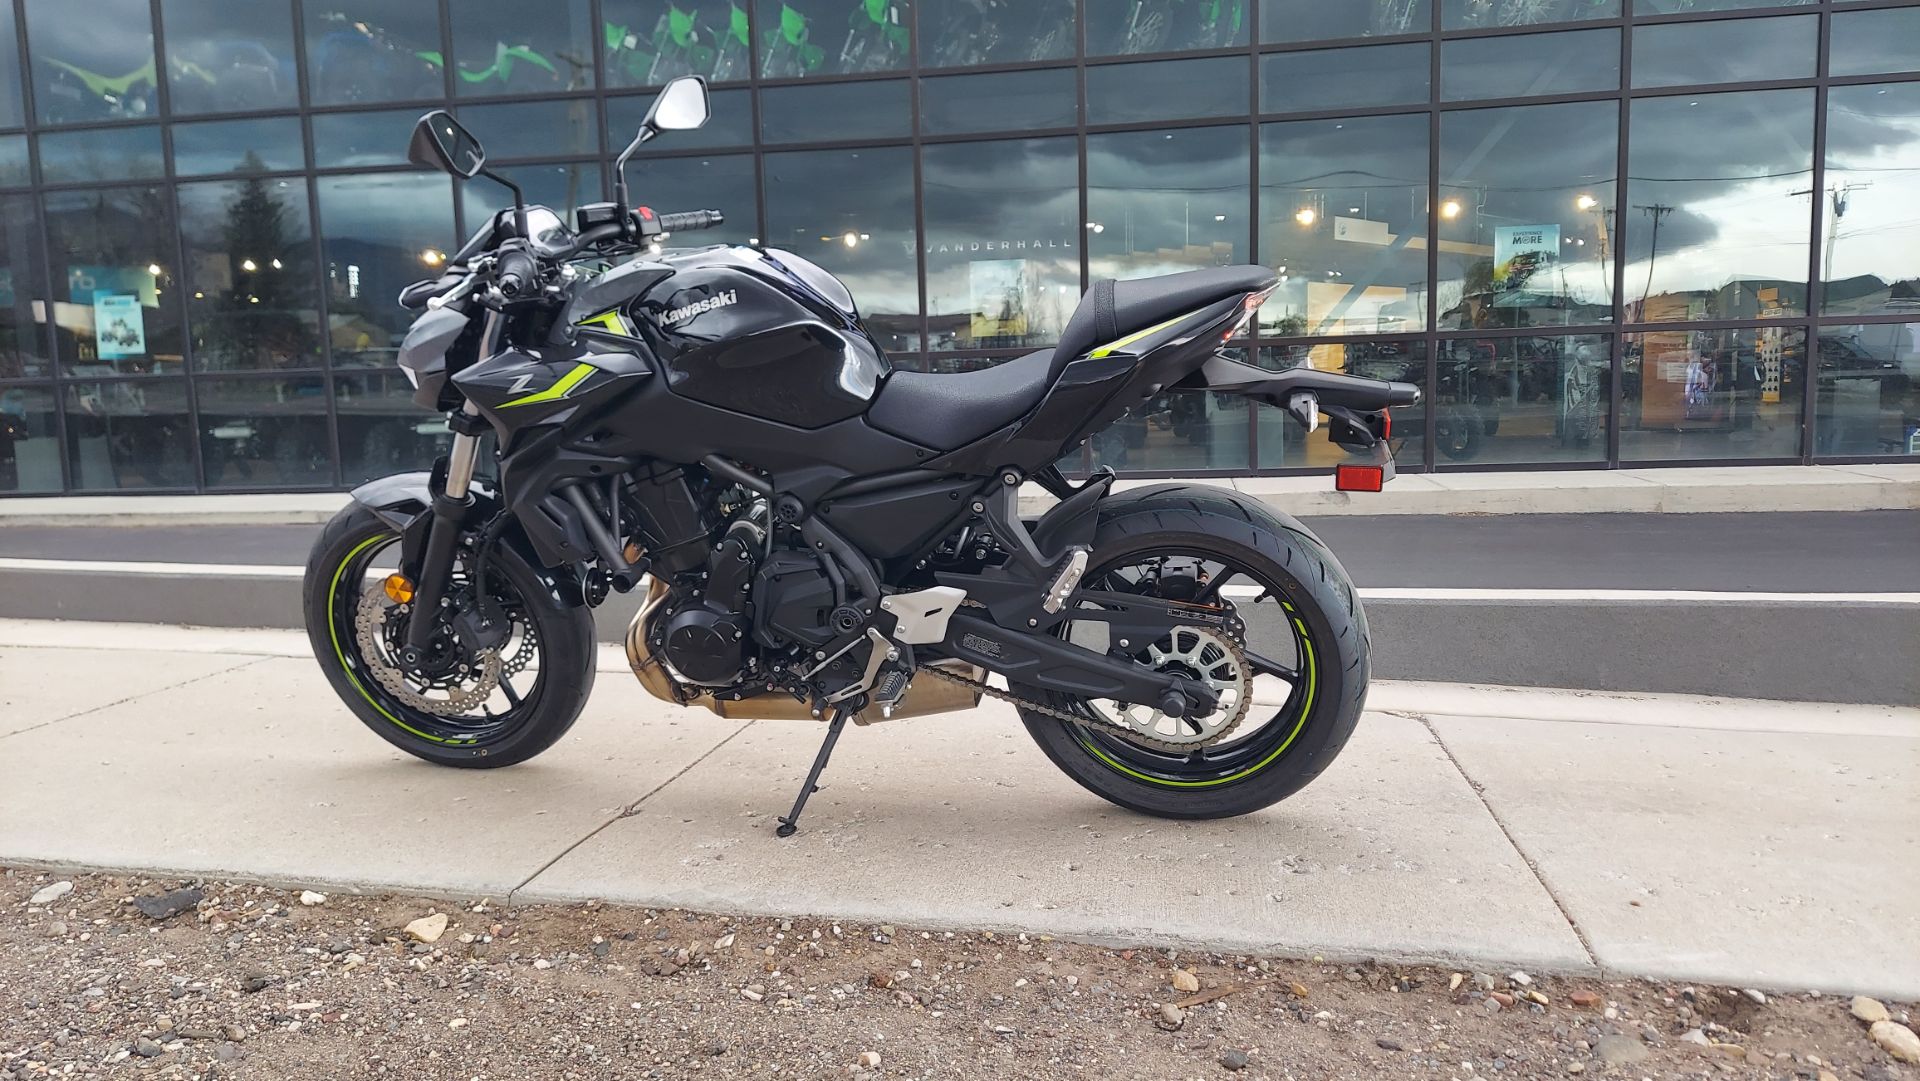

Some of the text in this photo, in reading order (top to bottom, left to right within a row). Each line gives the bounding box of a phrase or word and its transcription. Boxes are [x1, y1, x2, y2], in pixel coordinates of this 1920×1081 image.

[1512, 236, 1542, 245] MORE
[658, 289, 738, 327] Kawasaki
[506, 373, 537, 395] Z
